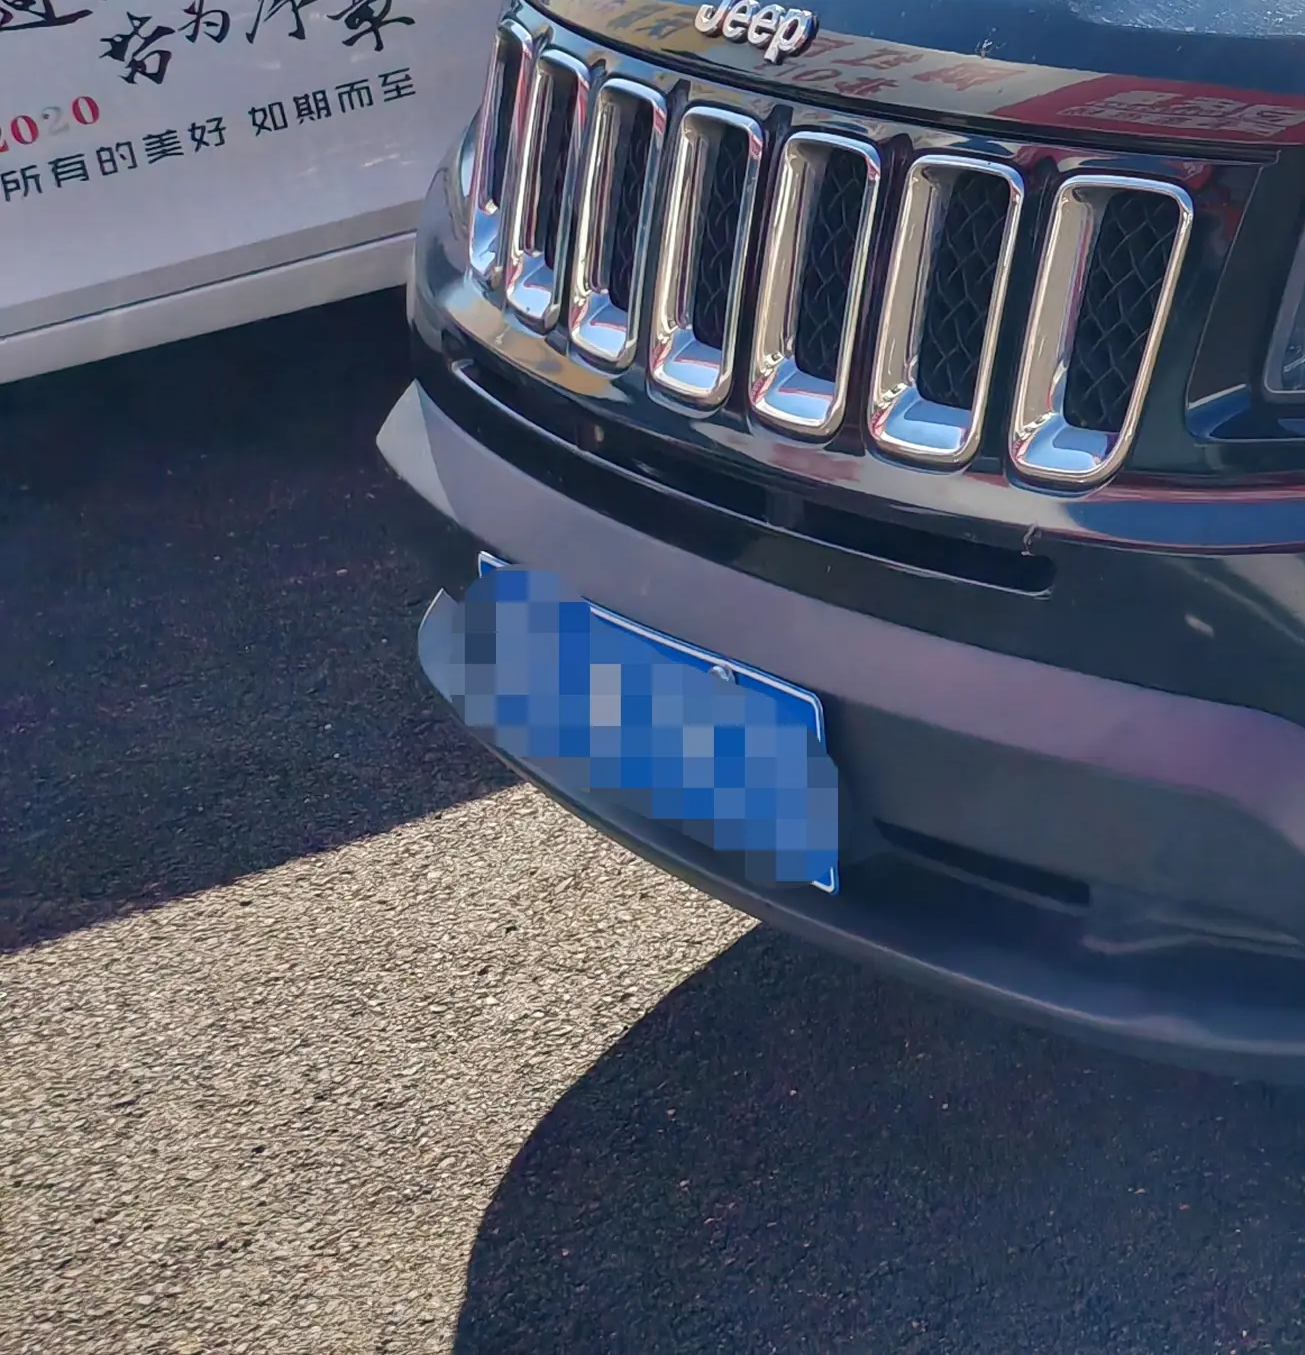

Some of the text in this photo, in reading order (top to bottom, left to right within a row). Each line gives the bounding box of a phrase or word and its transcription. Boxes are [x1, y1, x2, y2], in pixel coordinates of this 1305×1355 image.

[0, 67, 416, 202] 所有的美好 如期而至
